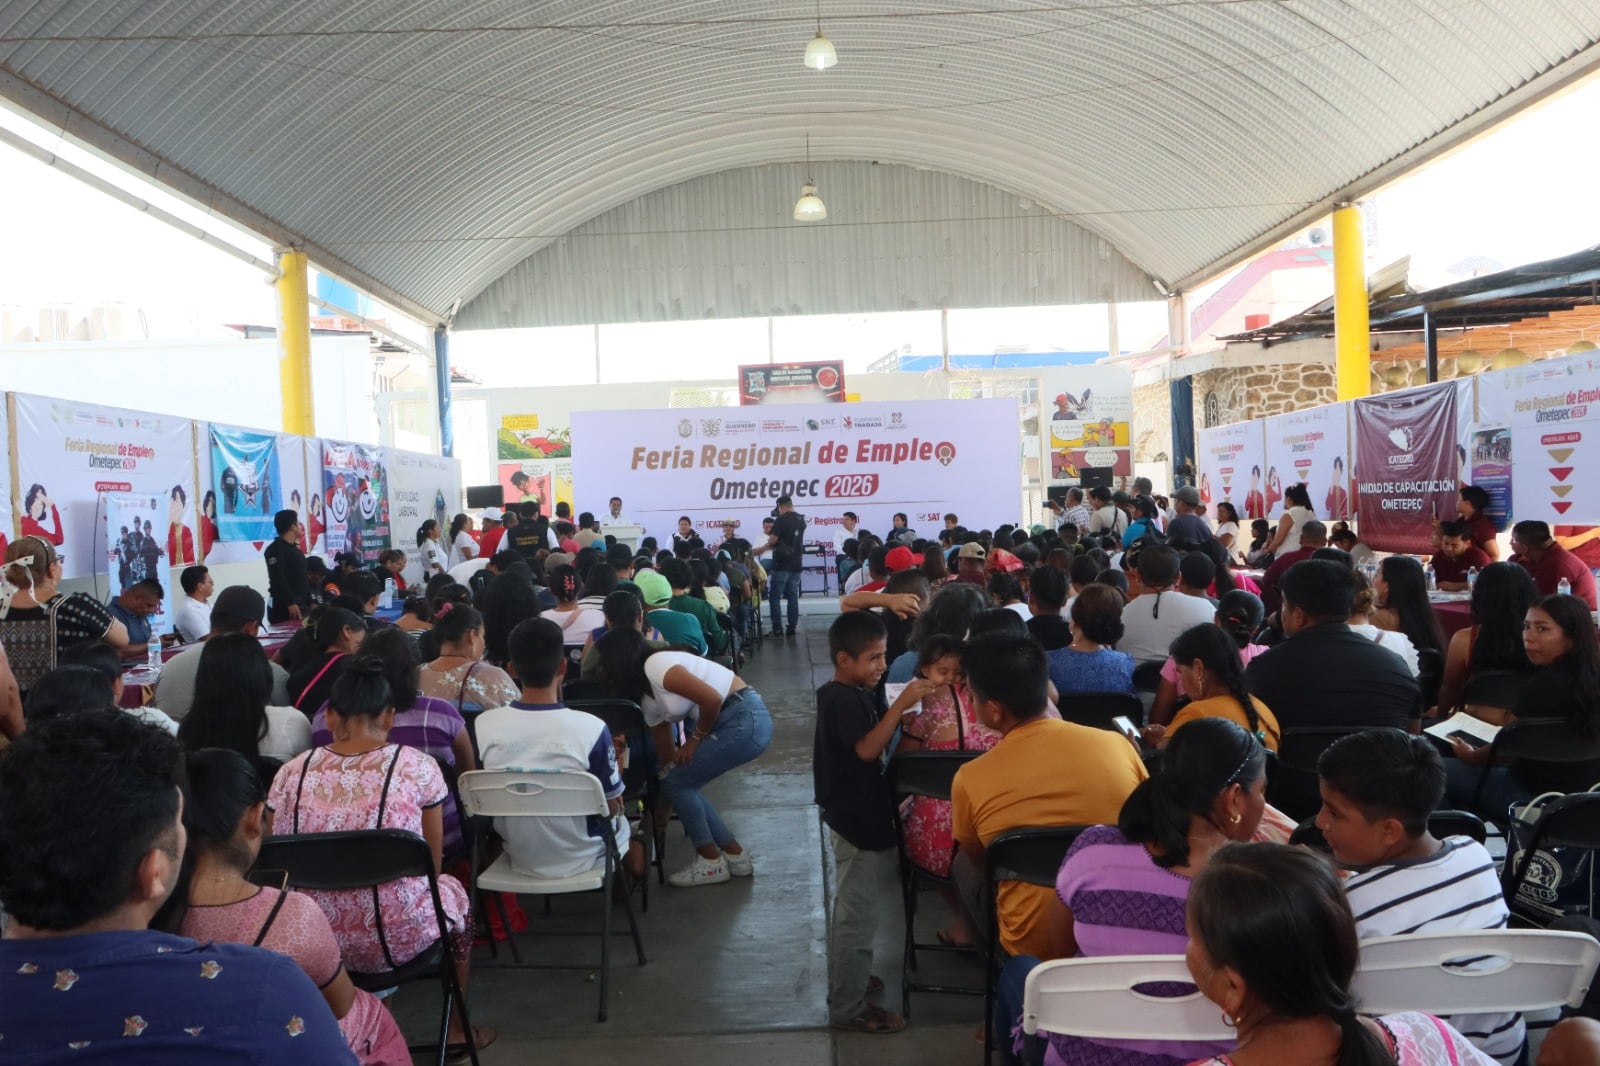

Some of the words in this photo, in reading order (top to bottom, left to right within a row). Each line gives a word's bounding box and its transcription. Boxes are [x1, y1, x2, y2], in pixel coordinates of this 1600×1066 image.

[1566, 391, 1576, 405] de
[1535, 408, 1570, 423] Ometepec
[118, 443, 127, 456] de
[631, 445, 695, 470] Feria
[700, 441, 812, 471] Regional
[818, 440, 849, 464] de
[89, 454, 122, 470] Ometepec
[709, 477, 820, 501] Ometepec
[829, 474, 874, 498] 2026
[1383, 482, 1394, 493] DE
[1395, 477, 1455, 493] CAPACITACIÓN
[1381, 498, 1423, 510] OMETEPEC
[927, 513, 941, 522] SAT
